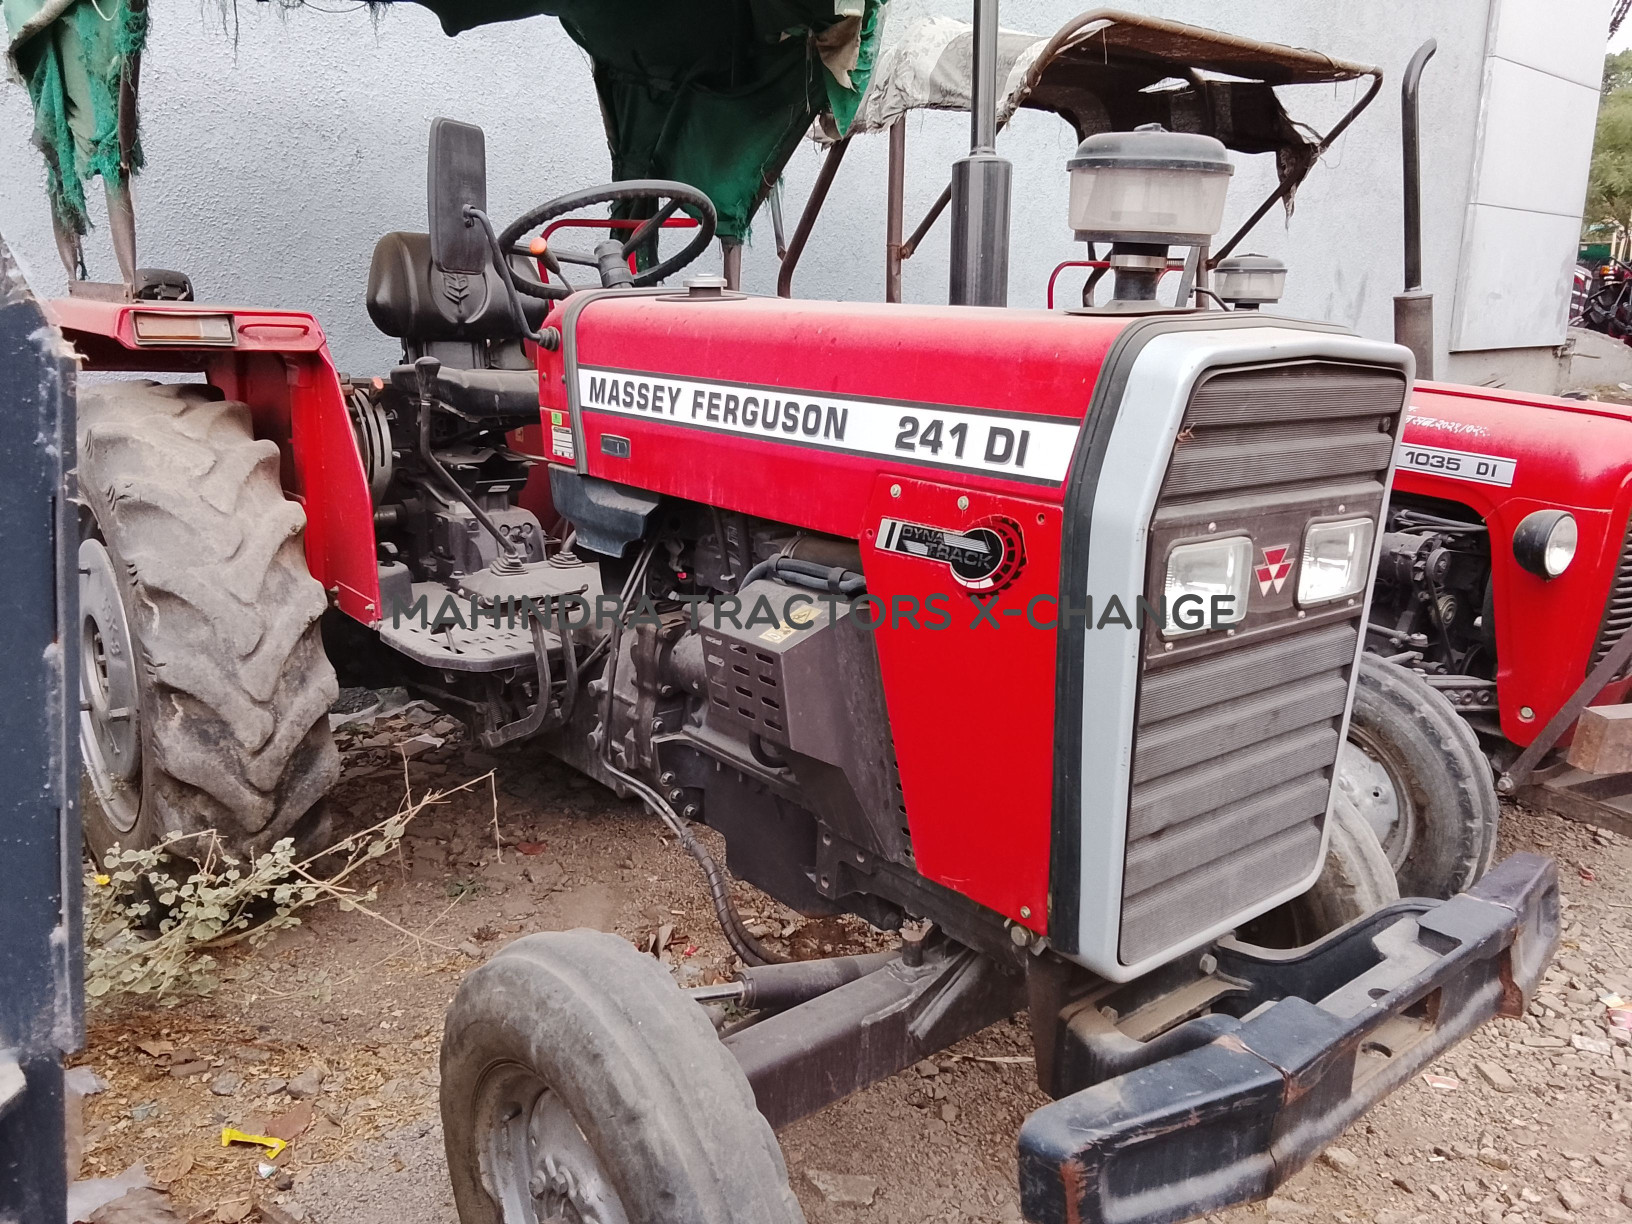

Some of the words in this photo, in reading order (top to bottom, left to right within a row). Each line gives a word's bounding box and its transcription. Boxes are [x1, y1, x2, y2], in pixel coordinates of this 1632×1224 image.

[589, 376, 681, 416] MASSEY
[691, 389, 849, 442] FERGUSON
[895, 415, 970, 460] 241
[984, 426, 1030, 468] DI
[1405, 451, 1462, 472] 1035
[1475, 461, 1498, 478] DI
[902, 526, 946, 545] DYNA
[925, 542, 993, 570] TRACK
